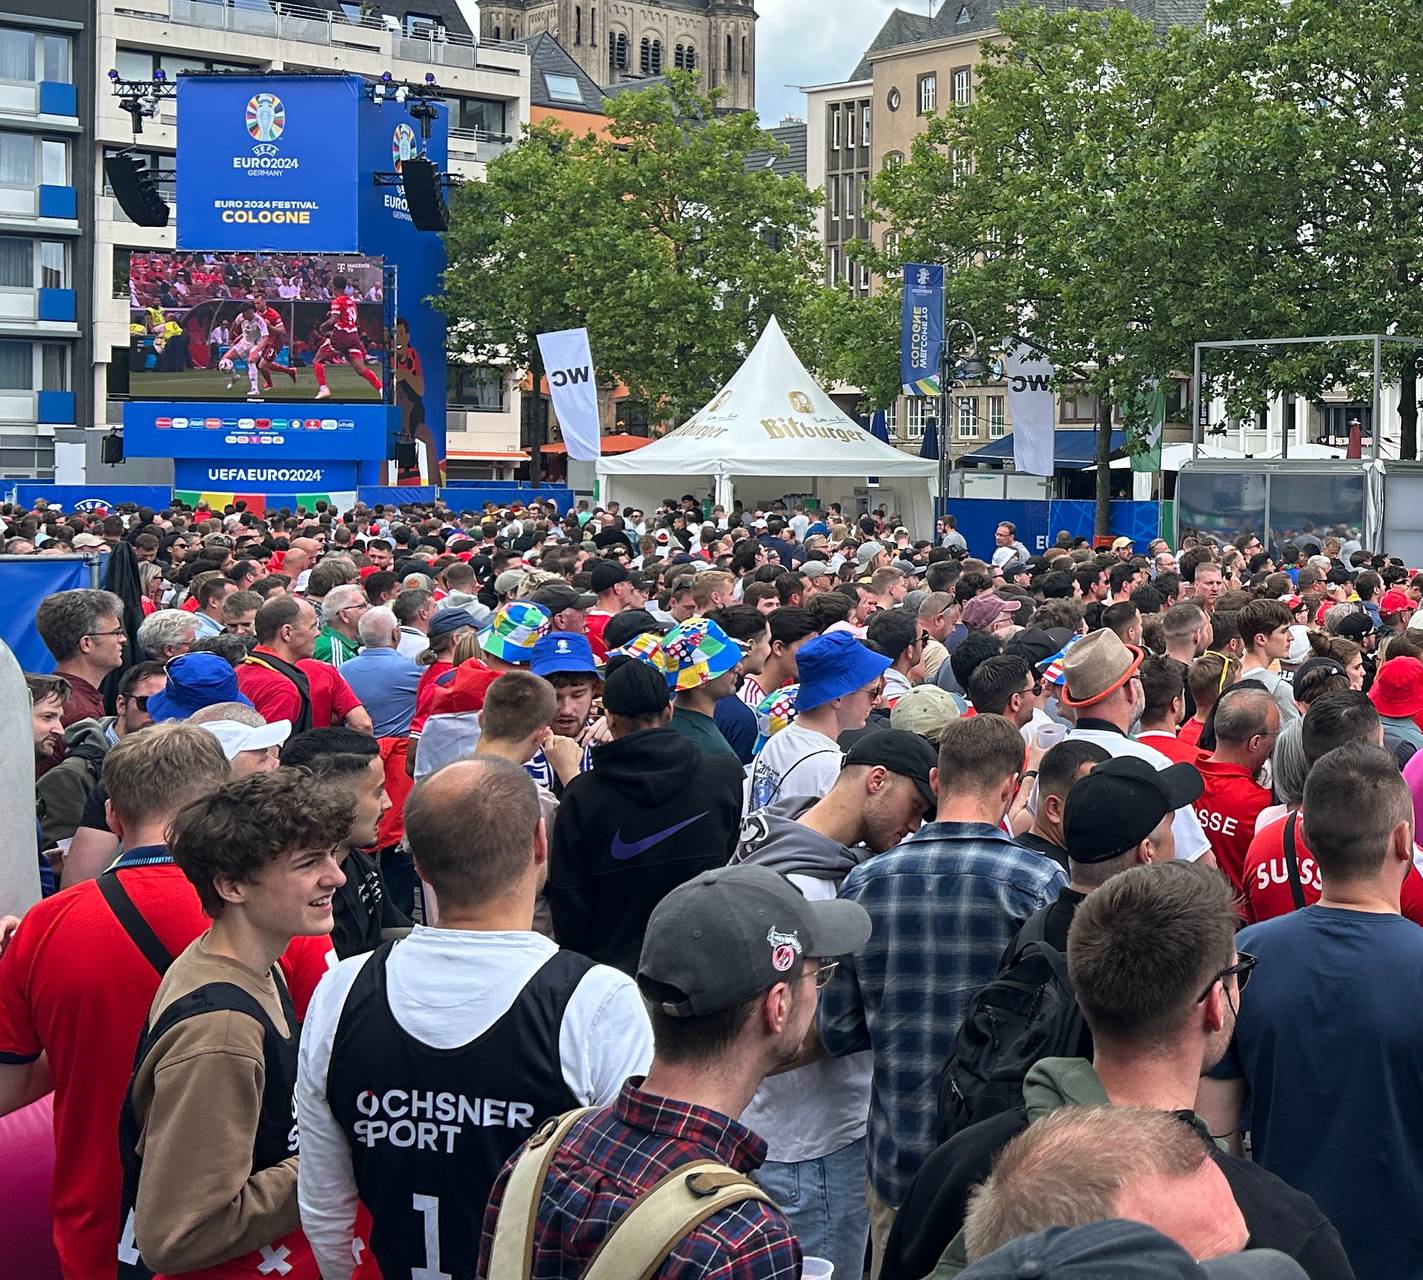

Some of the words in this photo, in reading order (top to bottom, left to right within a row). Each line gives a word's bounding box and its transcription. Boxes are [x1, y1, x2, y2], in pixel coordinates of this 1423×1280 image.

[253, 145, 277, 155] UEFA
[233, 157, 299, 169] EURO2024
[247, 169, 284, 177] GERMANY
[214, 200, 243, 208] EURO
[272, 201, 319, 210] FESTIVAL
[222, 210, 310, 224] COLOGNE
[760, 416, 866, 443] Bitburger
[1195, 808, 1238, 837] SSE
[356, 1088, 535, 1129] OCHSNER
[353, 1118, 462, 1154] SPORT
